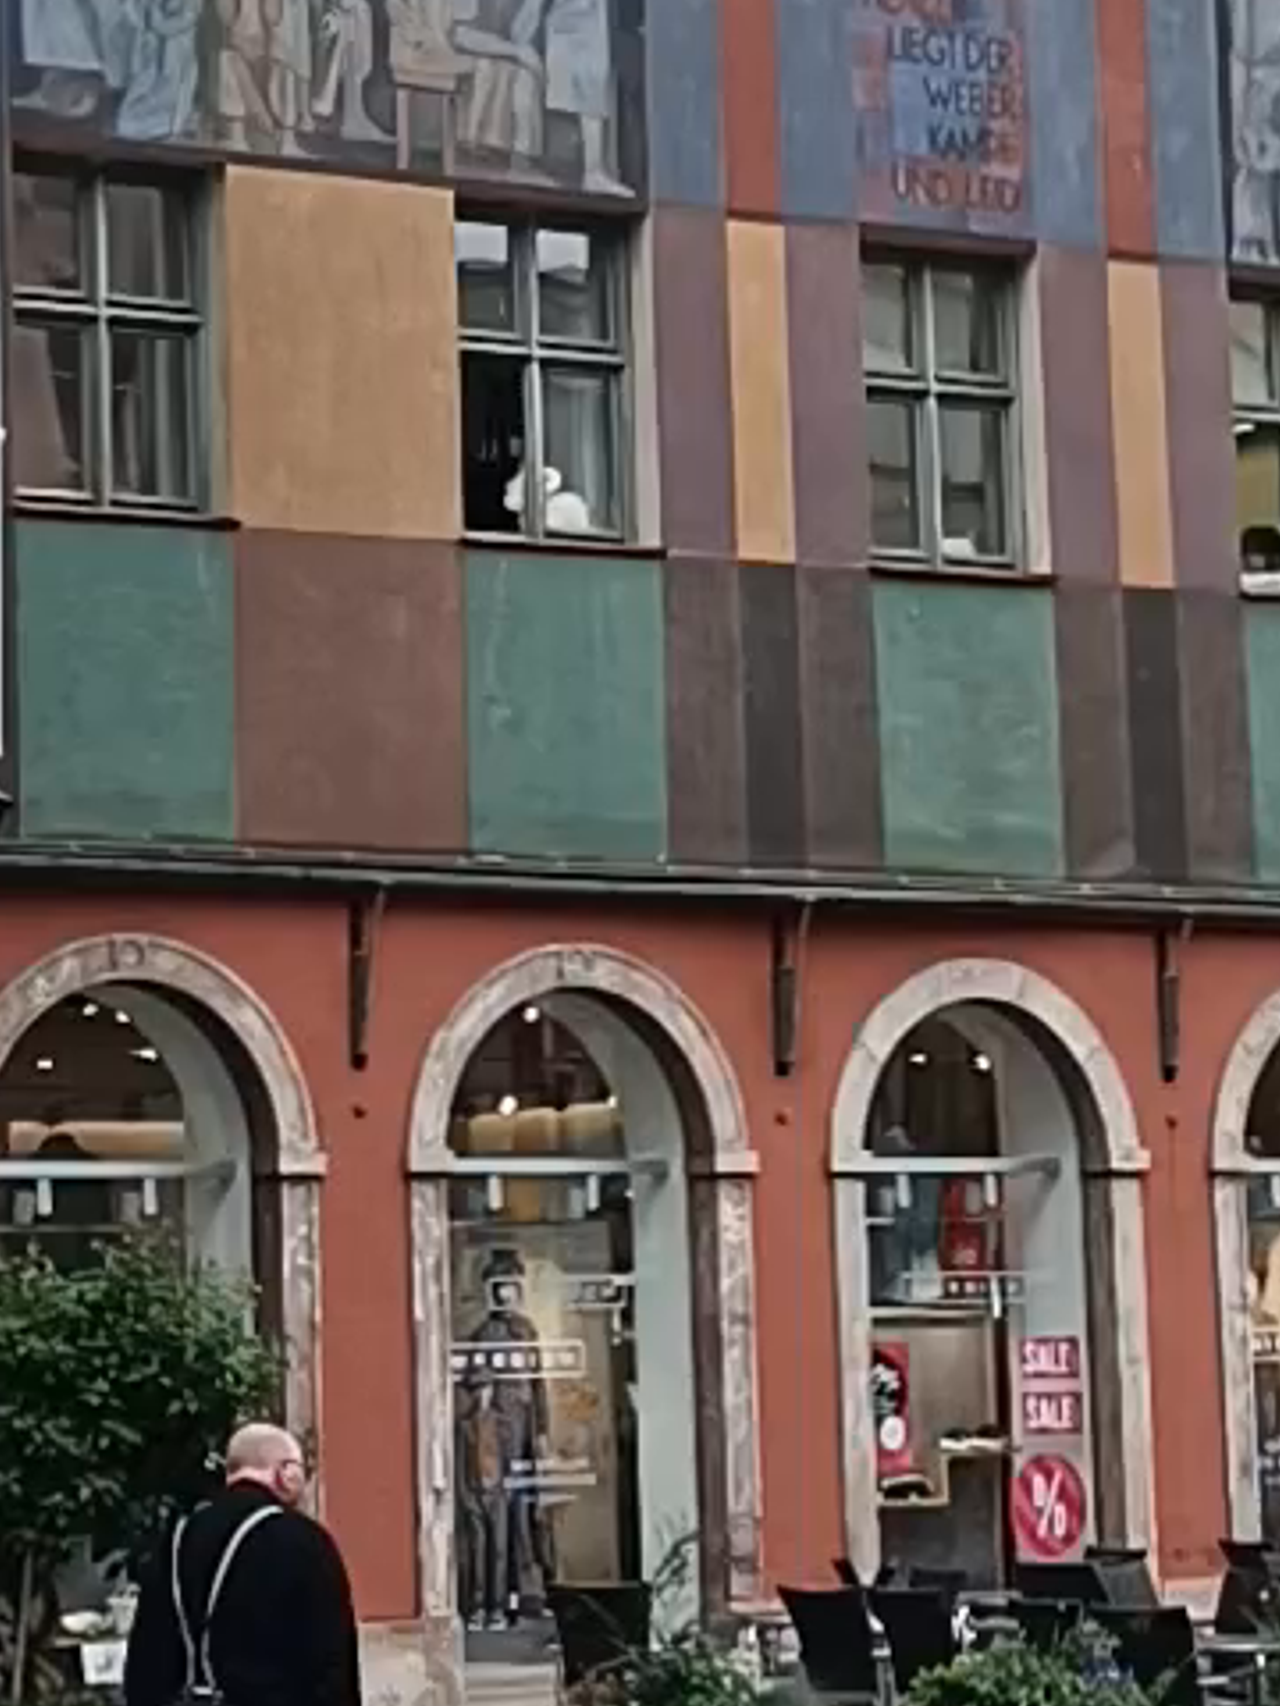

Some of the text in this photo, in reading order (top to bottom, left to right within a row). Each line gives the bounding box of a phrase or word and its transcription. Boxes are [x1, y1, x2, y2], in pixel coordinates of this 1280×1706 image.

[1023, 1341, 1071, 1373] SALE
[1025, 1394, 1074, 1429] SALE
[1032, 1470, 1066, 1538] %
